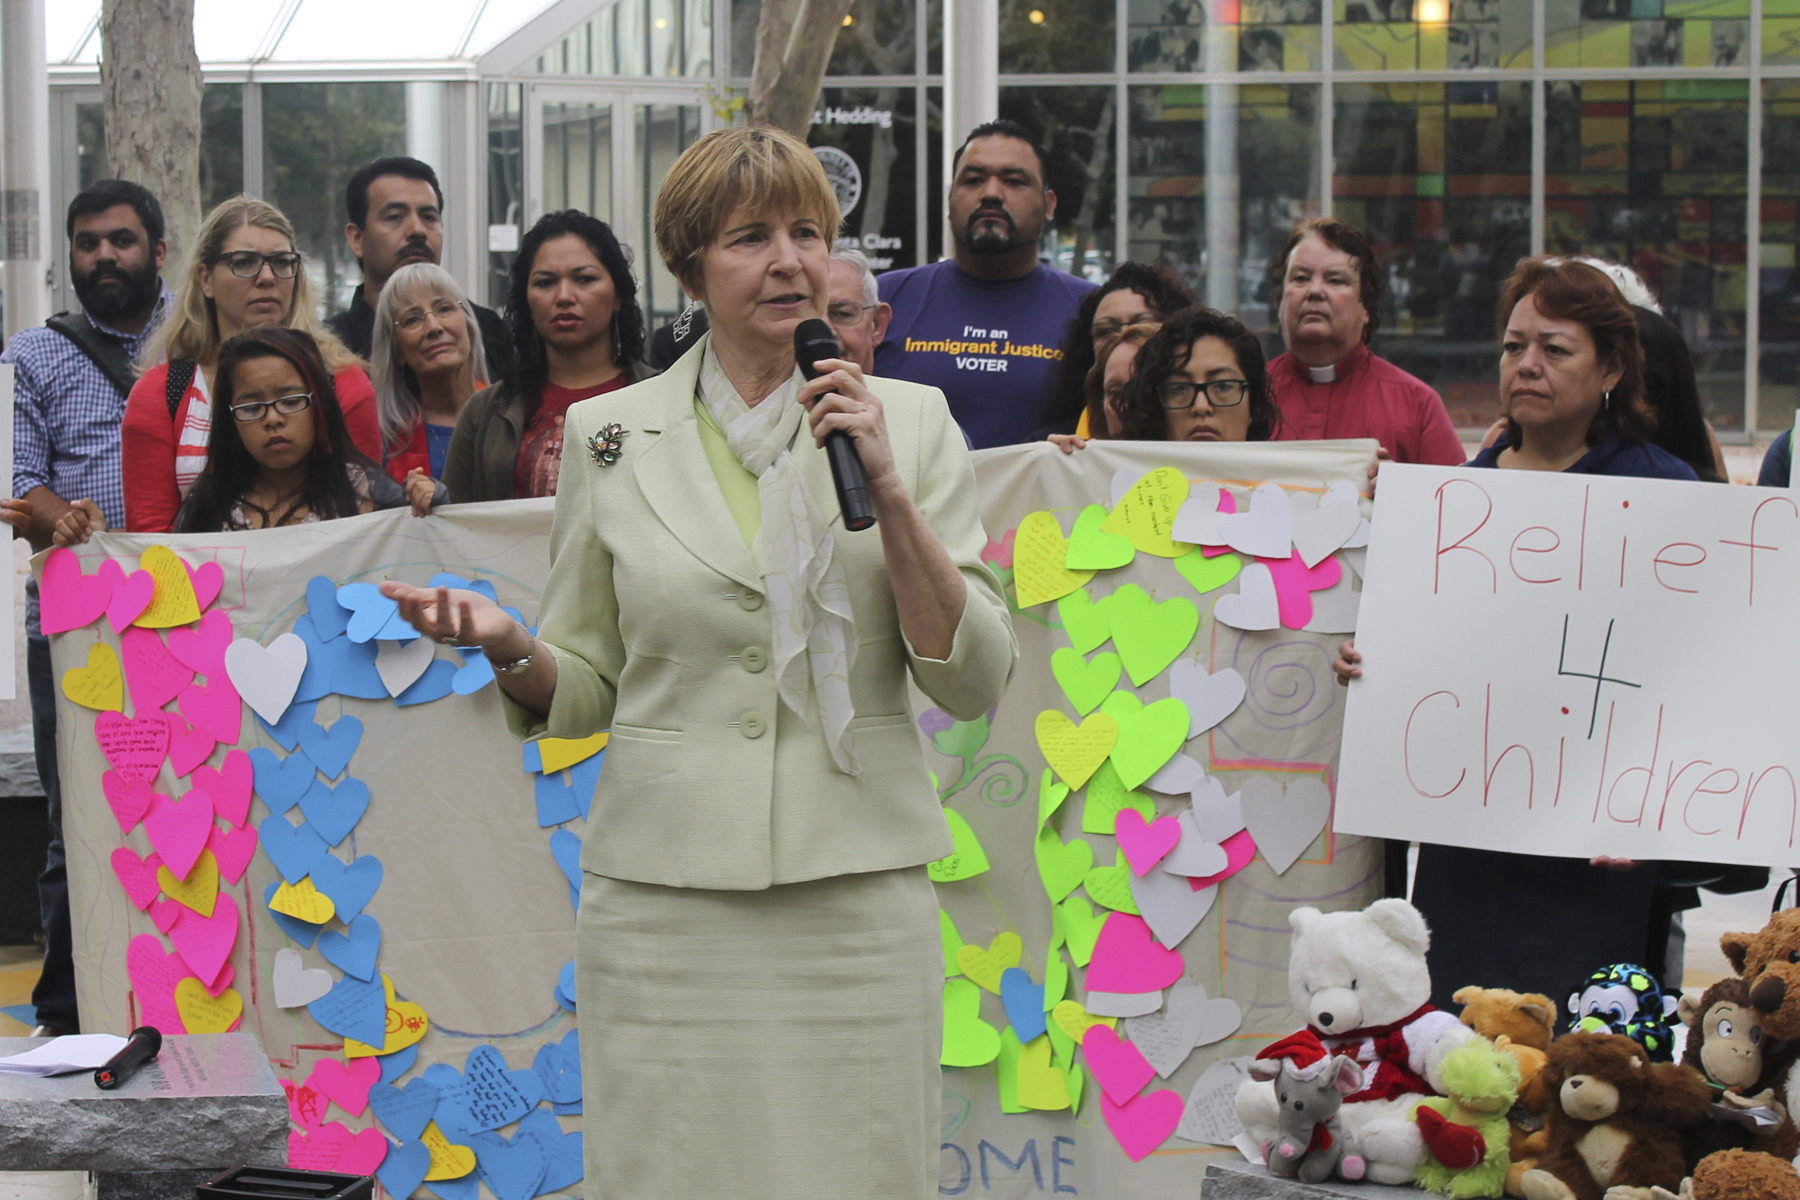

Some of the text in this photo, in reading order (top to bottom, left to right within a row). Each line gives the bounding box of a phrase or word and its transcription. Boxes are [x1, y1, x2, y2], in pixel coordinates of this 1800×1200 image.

[825, 105, 893, 129] Hedding
[862, 232, 902, 250] Clara
[963, 325, 1008, 340] I'm an
[905, 337, 1065, 361] Immigrant Justice
[955, 356, 1008, 373] VOTER
[1435, 478, 1799, 606] Relief
[1558, 613, 1642, 740] 4
[1404, 683, 1798, 848] Children
[938, 1135, 1078, 1196] OME
